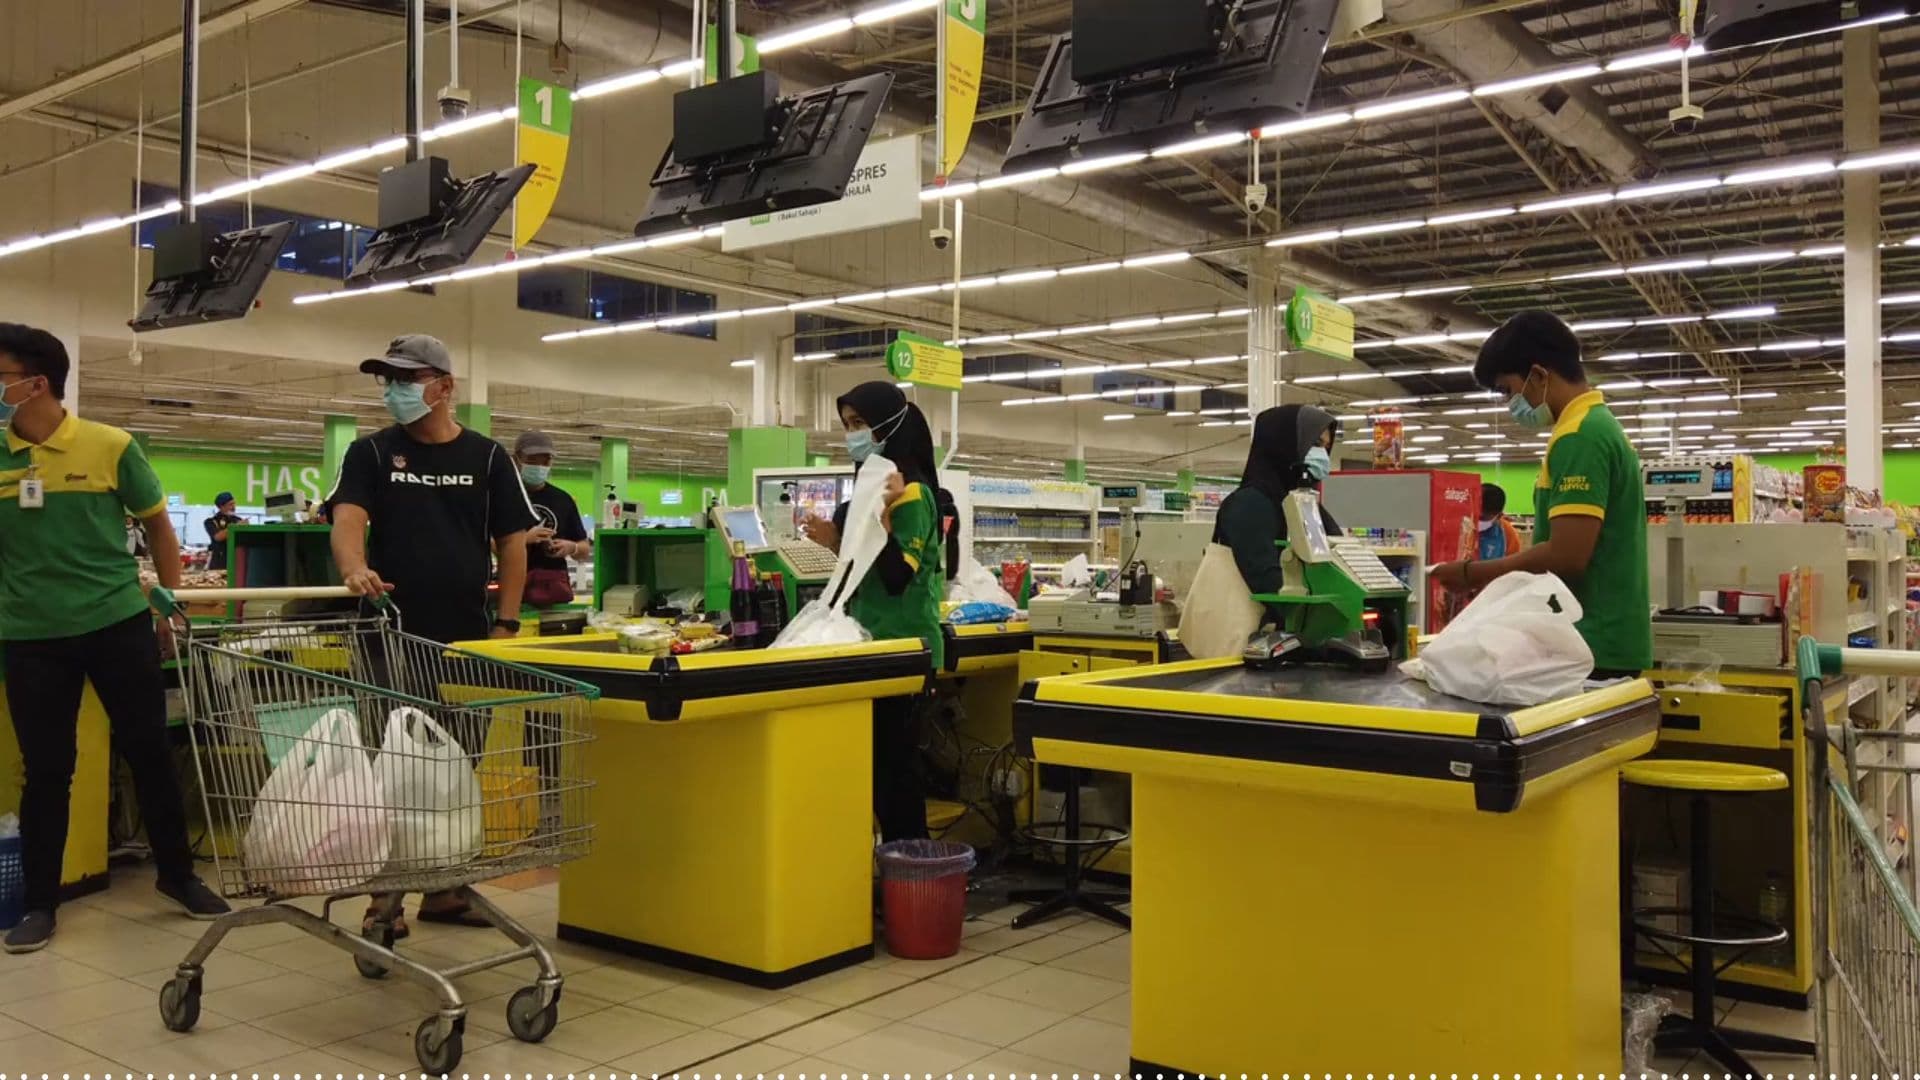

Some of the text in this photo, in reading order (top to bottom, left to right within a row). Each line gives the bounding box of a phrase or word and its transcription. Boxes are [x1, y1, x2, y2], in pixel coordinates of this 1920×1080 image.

[535, 86, 553, 126] 1
[1301, 311, 1310, 330] 11
[898, 352, 912, 368] 12
[246, 464, 321, 502] HAS
[390, 471, 474, 487] RACING
[1562, 475, 1588, 484] TRUST
